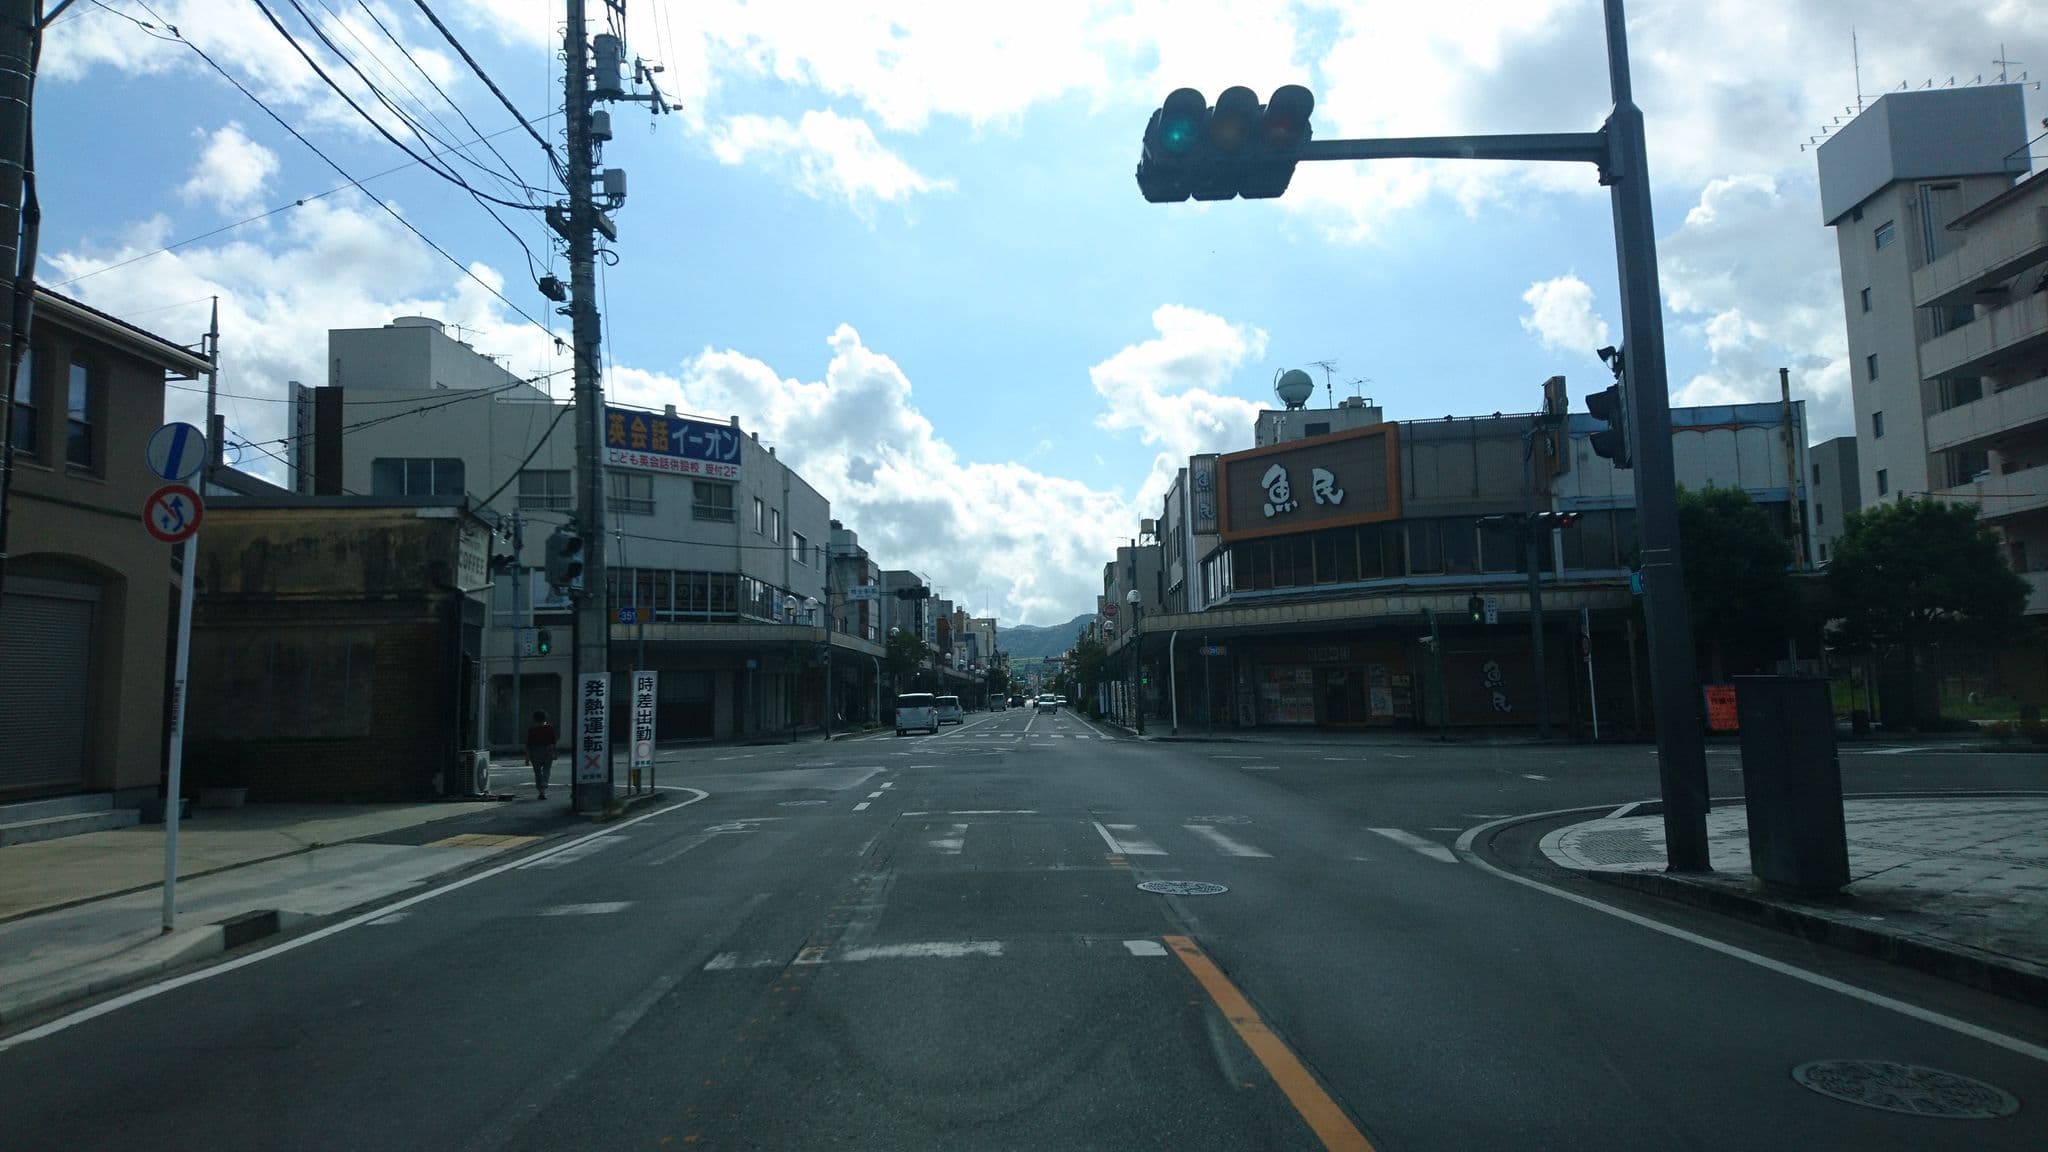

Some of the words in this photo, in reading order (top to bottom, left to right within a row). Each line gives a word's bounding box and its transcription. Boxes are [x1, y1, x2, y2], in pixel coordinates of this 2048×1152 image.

[1193, 470, 1216, 520] 魚民
[1262, 464, 1344, 517] 魚民
[584, 680, 604, 753] 発熱運転
[637, 677, 653, 742] 時差出勤
